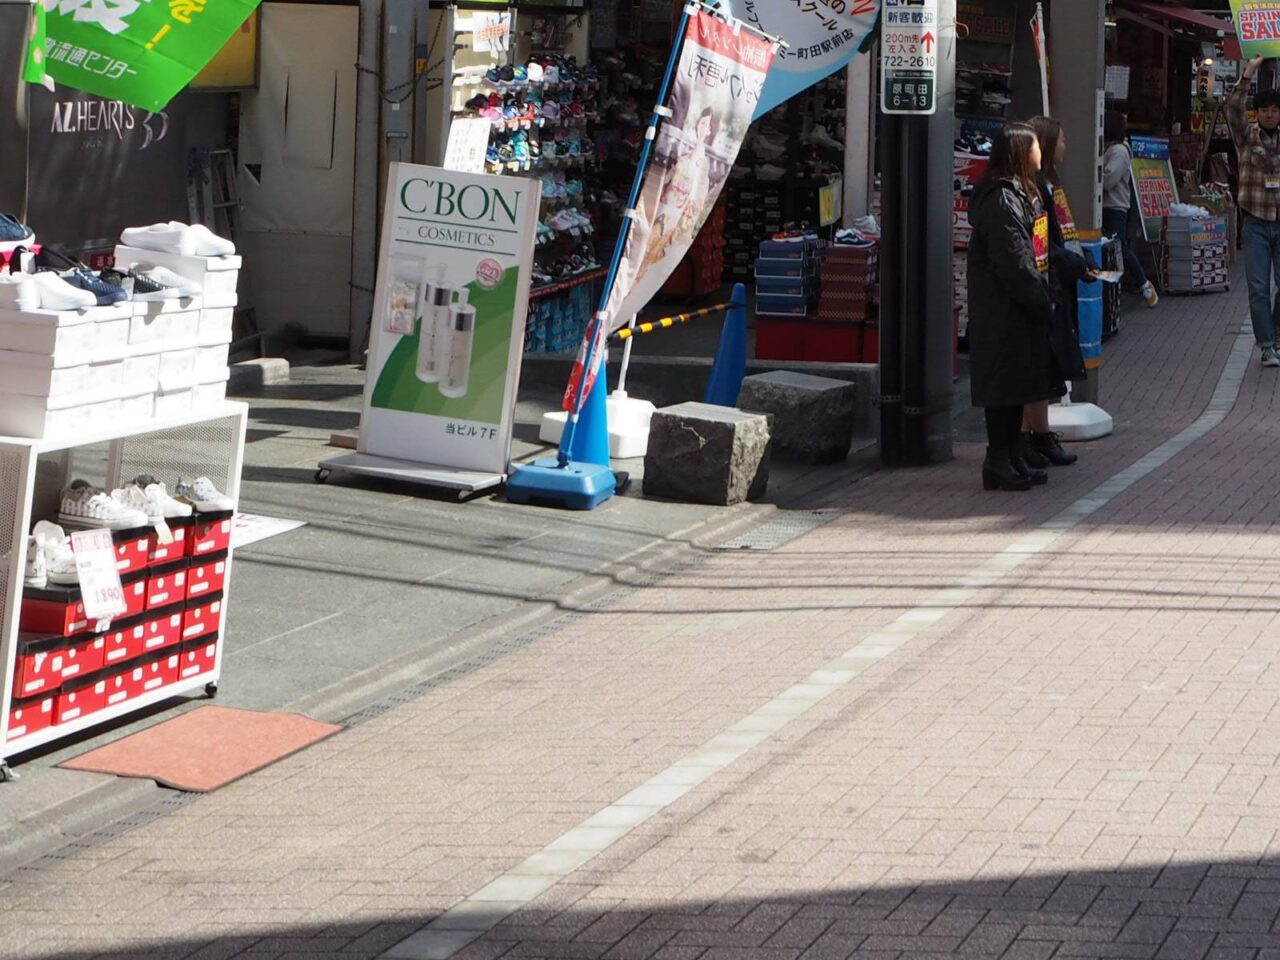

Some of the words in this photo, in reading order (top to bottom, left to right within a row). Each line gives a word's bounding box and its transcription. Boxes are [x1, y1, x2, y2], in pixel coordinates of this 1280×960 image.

[887, 11, 934, 25] 新客歓迎
[885, 33, 919, 44] 200m先
[888, 44, 917, 54] 左入る
[884, 55, 936, 67] 722-2610
[892, 83, 928, 95] 原町田
[893, 95, 927, 107] 6-13
[1139, 180, 1170, 192] SPRING
[400, 178, 522, 225] C'BON
[418, 226, 495, 248] COSMETICS
